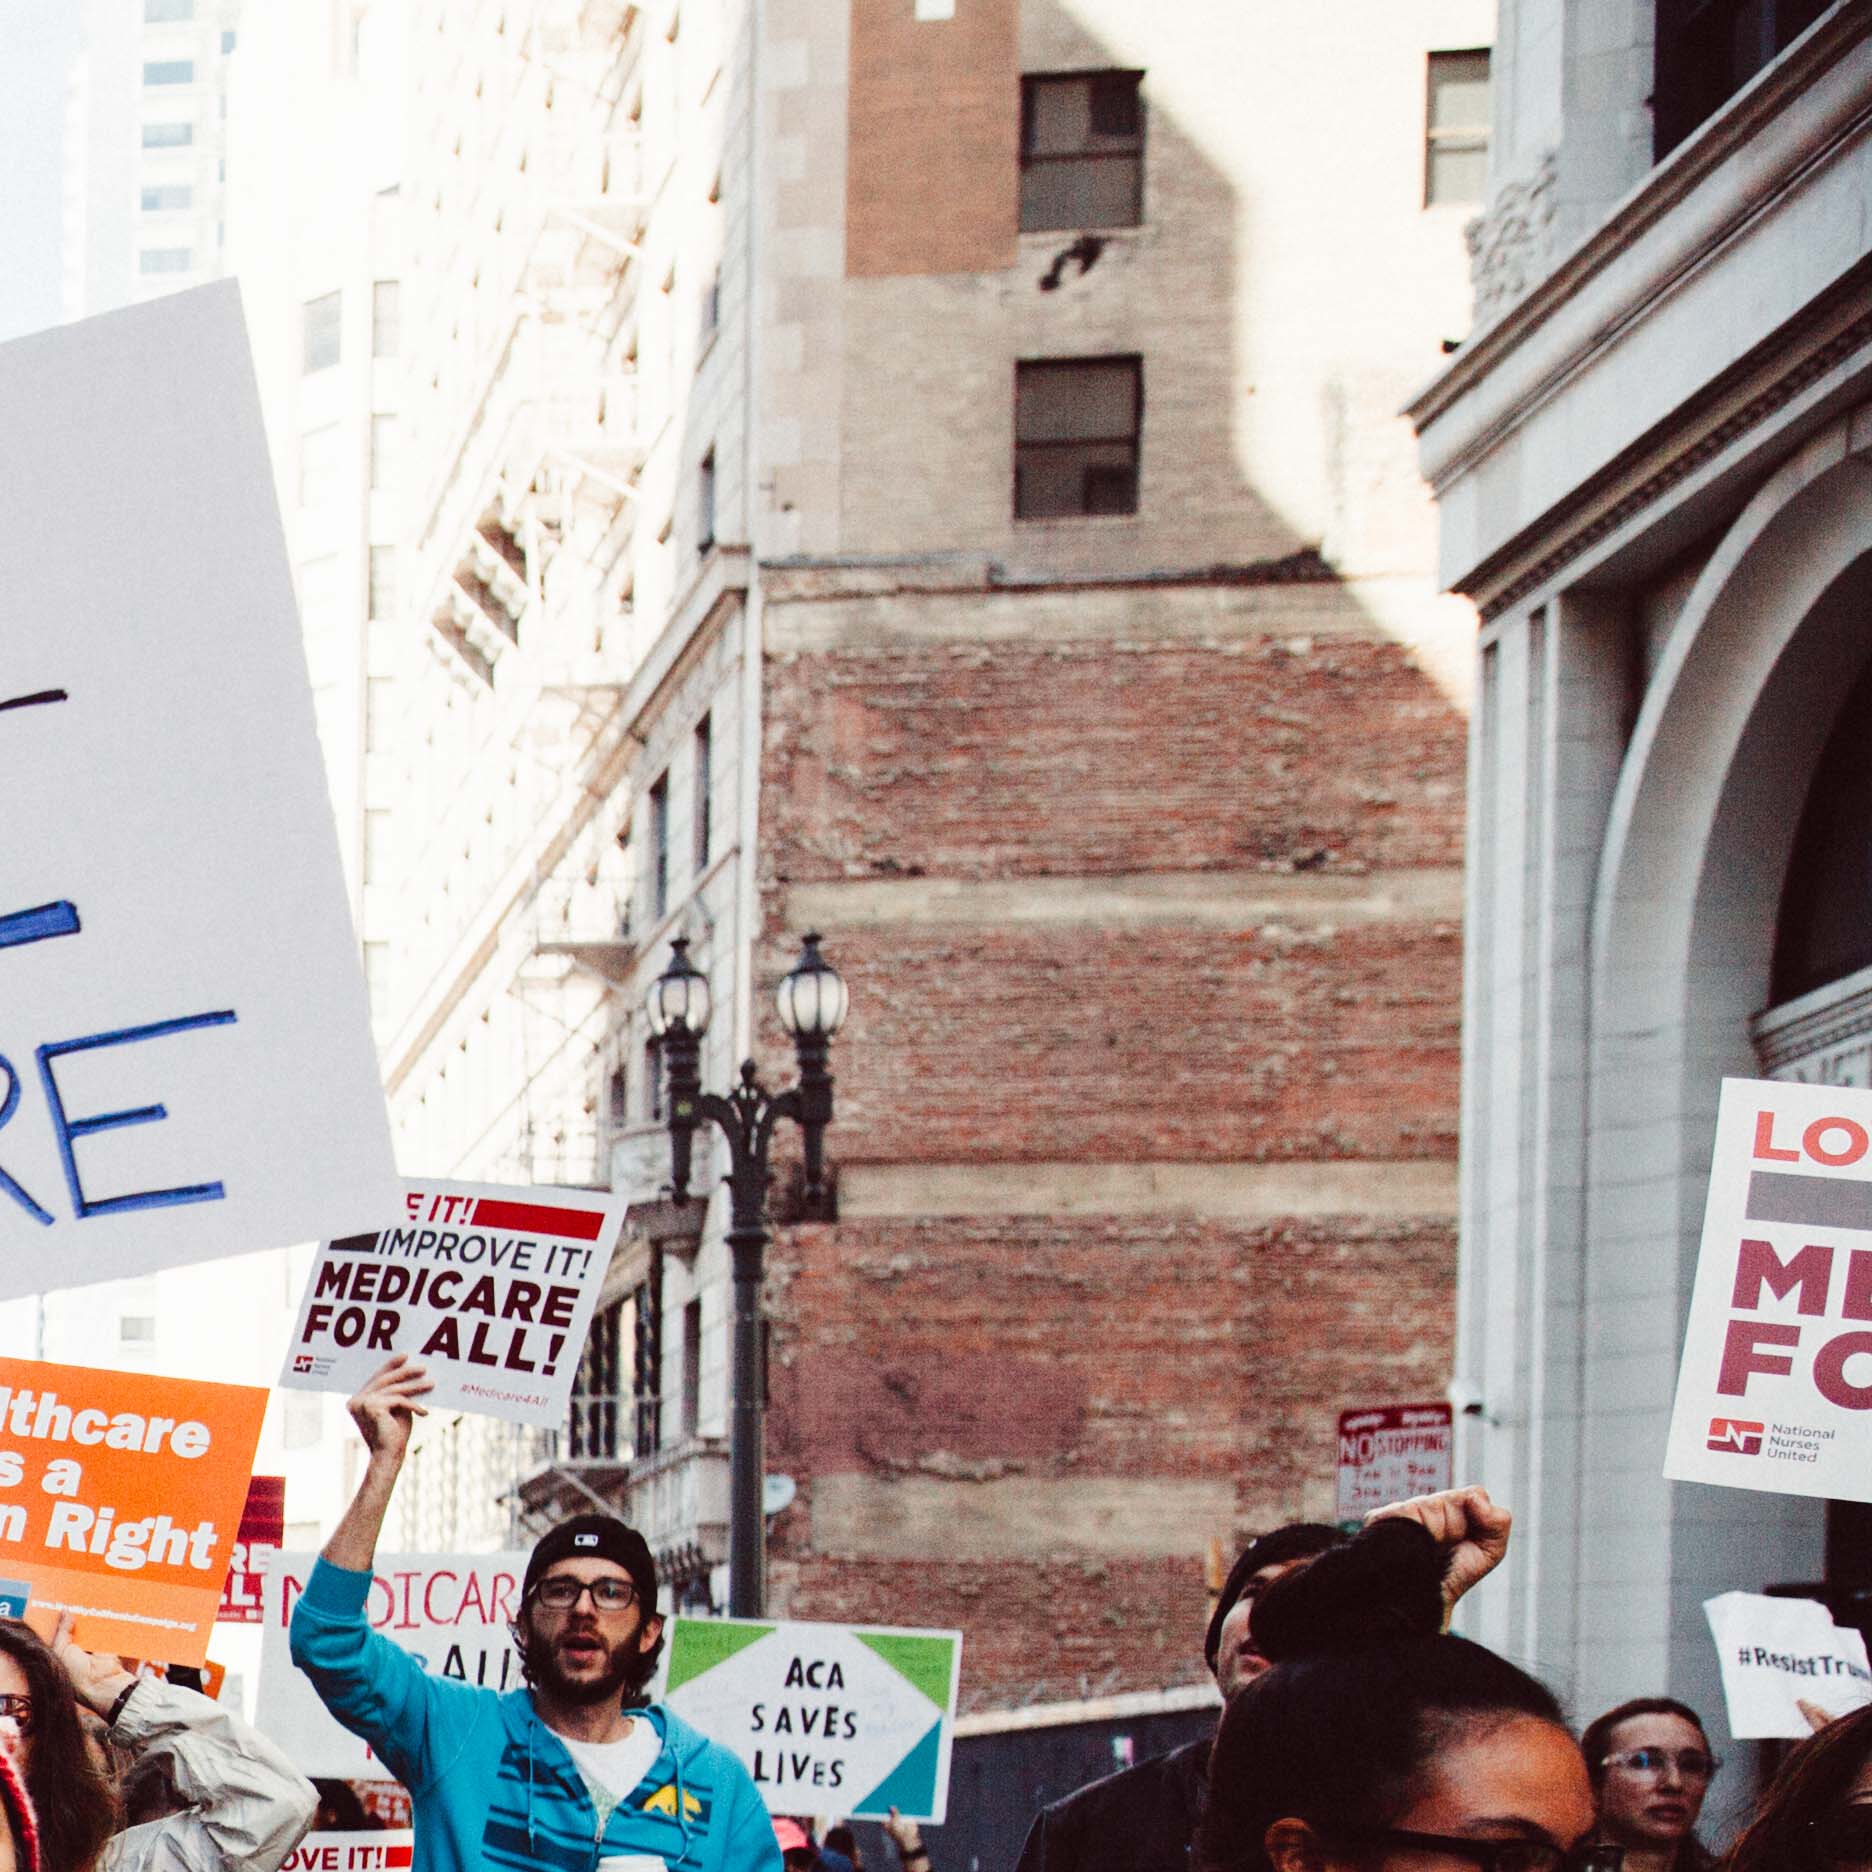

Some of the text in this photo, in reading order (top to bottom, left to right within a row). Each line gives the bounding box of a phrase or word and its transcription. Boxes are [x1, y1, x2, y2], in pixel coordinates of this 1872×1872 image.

[1754, 1111, 1869, 1168] LO
[428, 1195, 473, 1225] IT!
[379, 1228, 593, 1279] IMPROVE IT!
[314, 1261, 580, 1328] MEDICARE
[302, 1305, 566, 1375] FOR ALL!
[1717, 1320, 1872, 1411] FO
[1340, 1433, 1374, 1465] NO
[1770, 1436, 1821, 1452] Nurses
[1772, 1423, 1836, 1441] National
[1767, 1448, 1818, 1463] United
[42, 1461, 82, 1497] a
[46, 1501, 218, 1572] Right
[785, 1657, 844, 1690] ACA
[751, 1704, 858, 1738] SAVES
[754, 1750, 844, 1787] LIVES
[280, 1847, 381, 1872] OVE IT!
